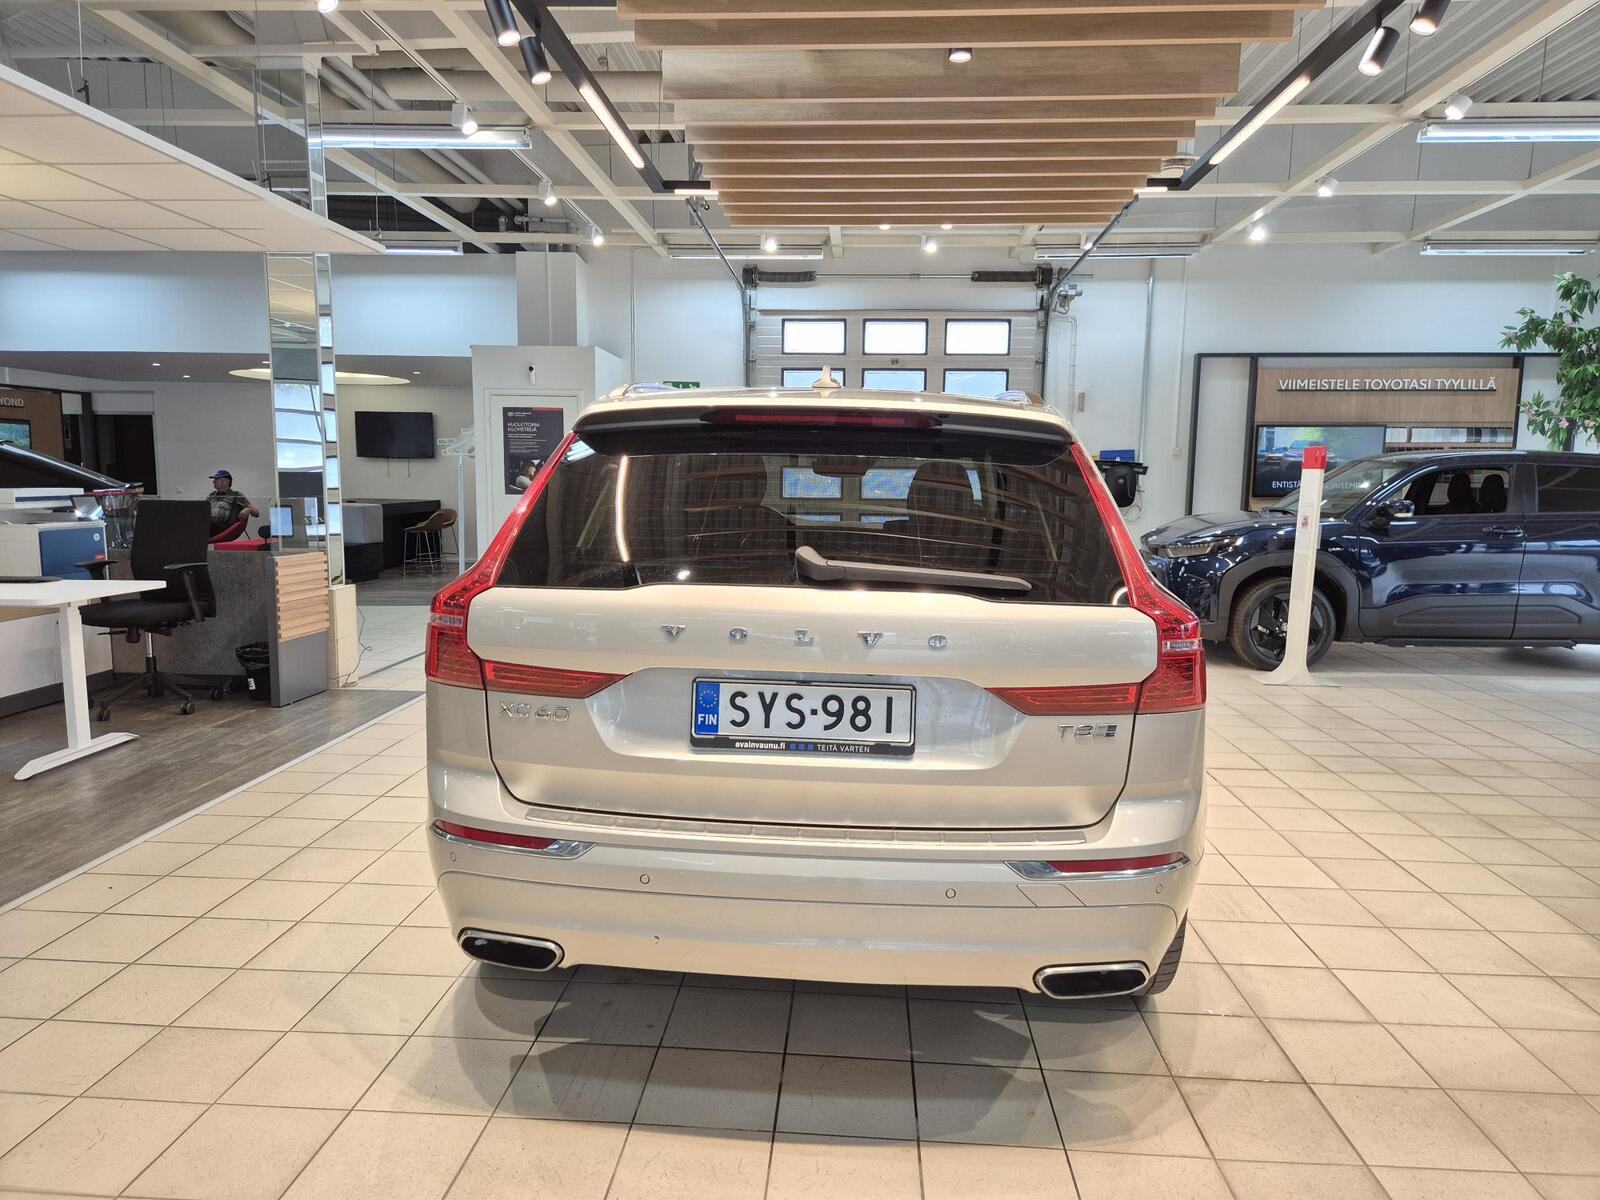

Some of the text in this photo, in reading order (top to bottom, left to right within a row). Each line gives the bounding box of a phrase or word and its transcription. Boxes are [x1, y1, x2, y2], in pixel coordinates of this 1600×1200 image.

[1279, 377, 1496, 390] VIIMEISTELE TOYOTASI TYYLILLÄ
[660, 624, 948, 651] VOLVO
[499, 702, 570, 721] XC60
[698, 690, 893, 734] FIN SYS-981
[735, 740, 870, 754] avainvaunu.fi TEITÄ VARTEN
